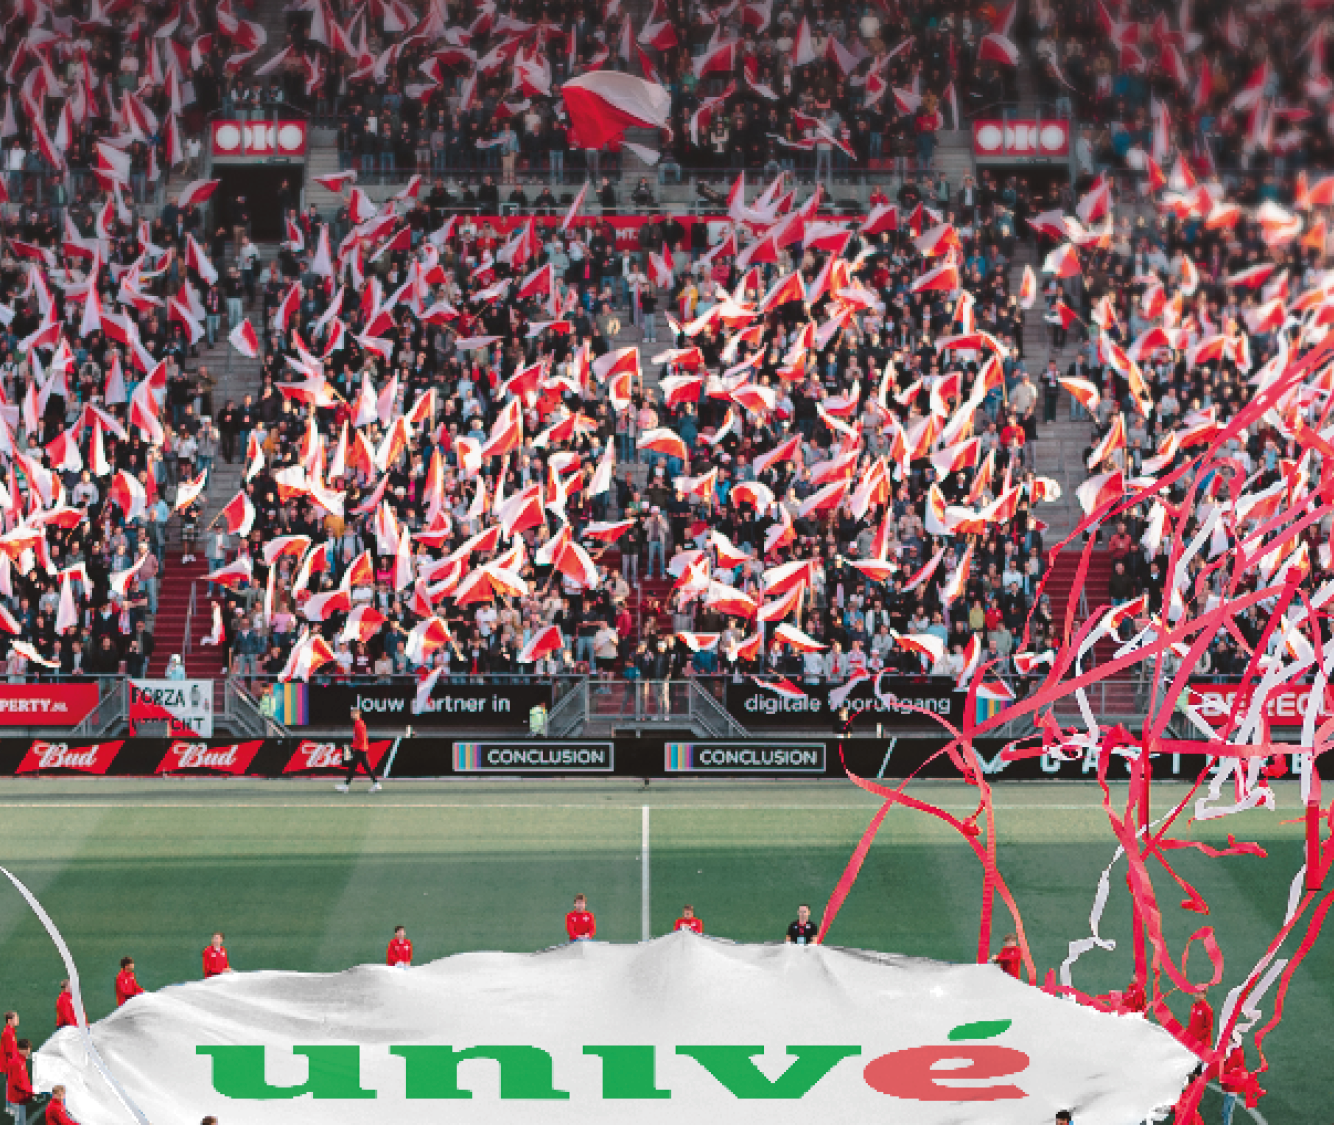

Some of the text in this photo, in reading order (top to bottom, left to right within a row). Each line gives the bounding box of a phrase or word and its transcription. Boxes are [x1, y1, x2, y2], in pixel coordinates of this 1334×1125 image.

[492, 694, 511, 712] in
[743, 693, 823, 714] digitale
[33, 742, 99, 768] Bud
[174, 742, 239, 768] Bud
[487, 749, 605, 765] CONCLUSION
[699, 750, 818, 765] CONCLUSION
[195, 1018, 1030, 1101] univé
